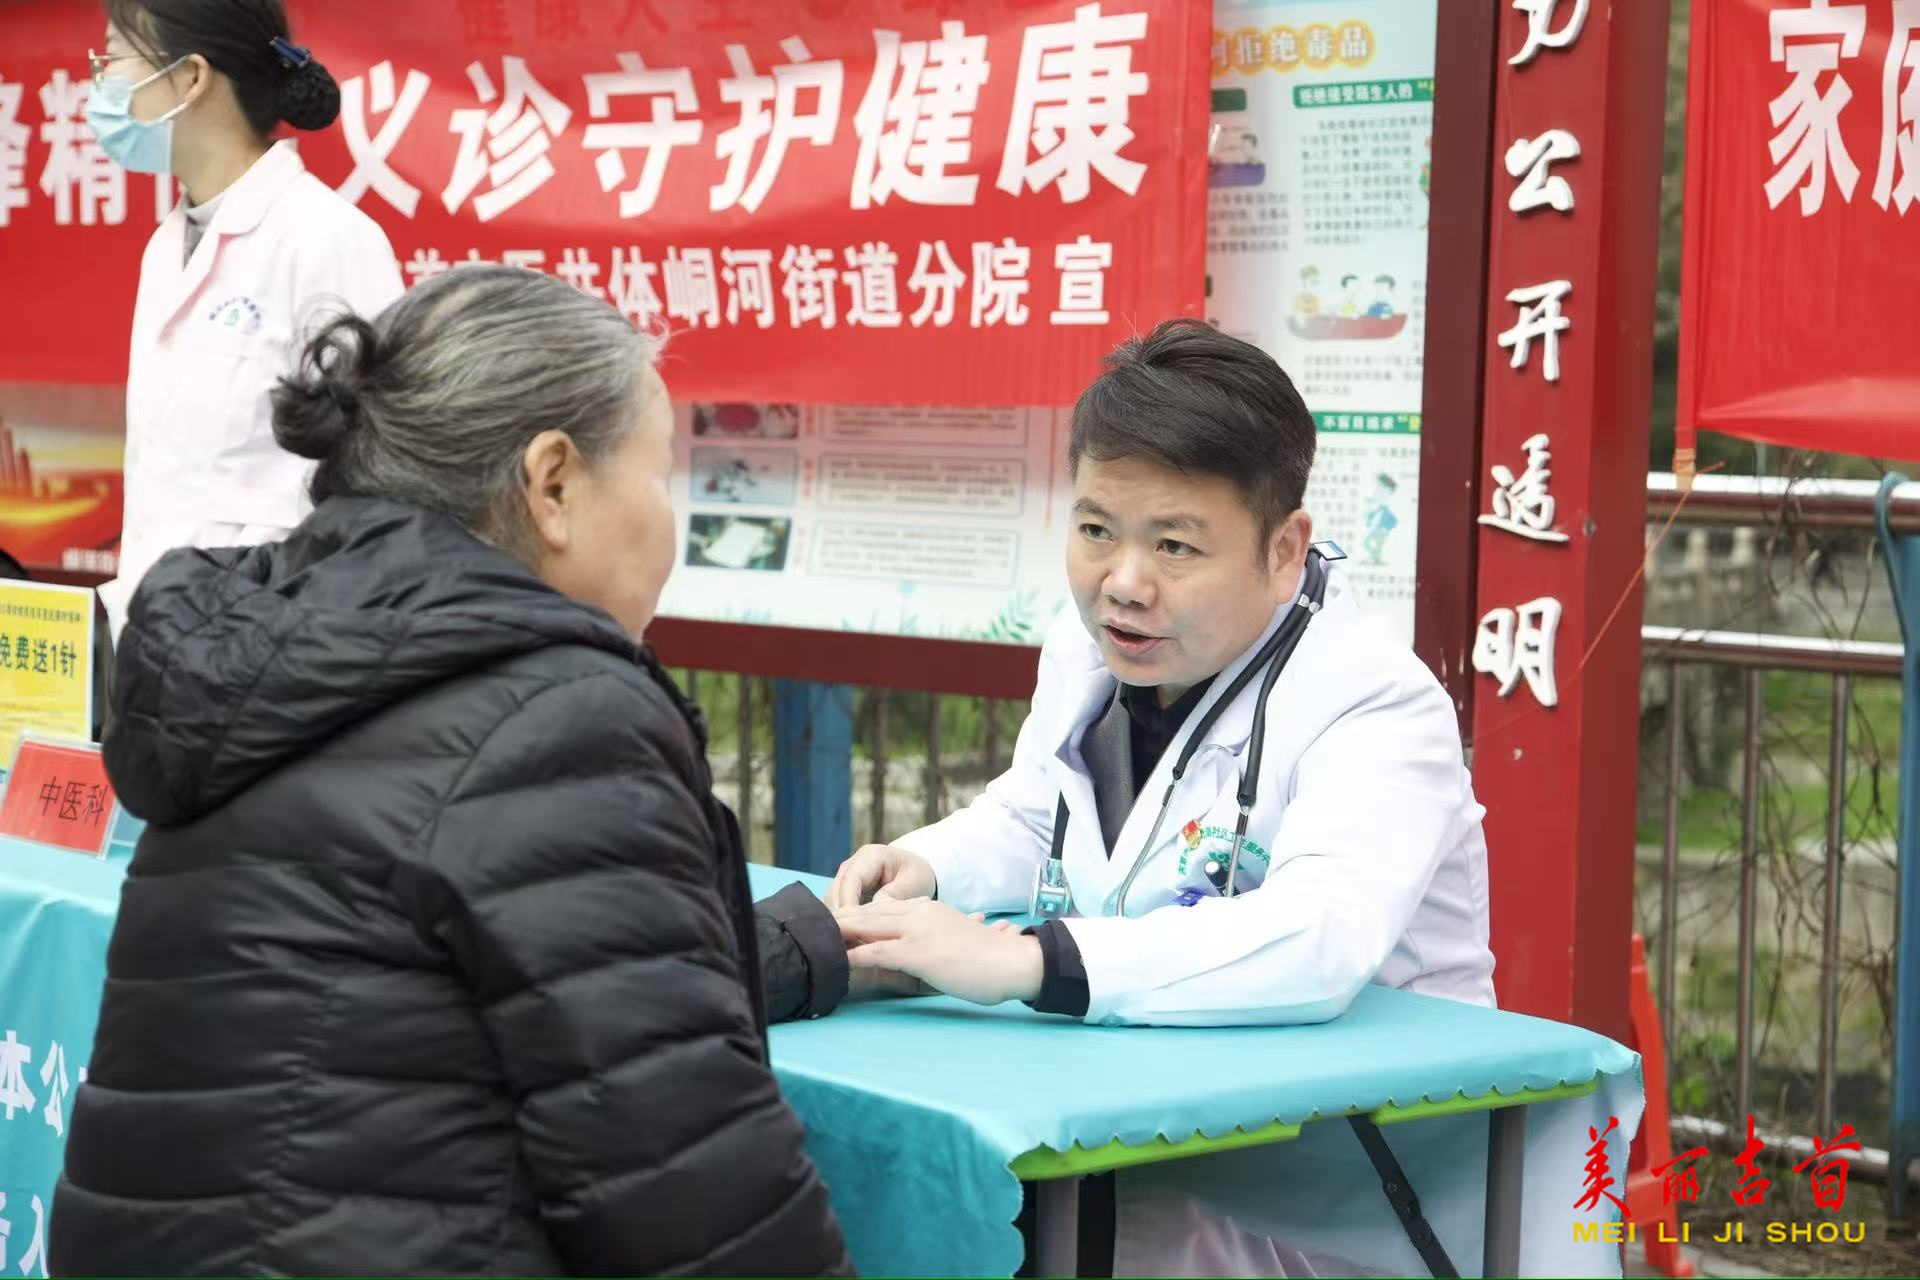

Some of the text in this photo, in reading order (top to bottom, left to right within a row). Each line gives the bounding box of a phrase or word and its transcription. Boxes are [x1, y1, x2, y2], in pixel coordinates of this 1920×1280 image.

[337, 2, 1150, 222] 义诊守护健康
[404, 235, 1113, 329] 共体峒河街道分院 宣
[39, 776, 109, 826] 中医科
